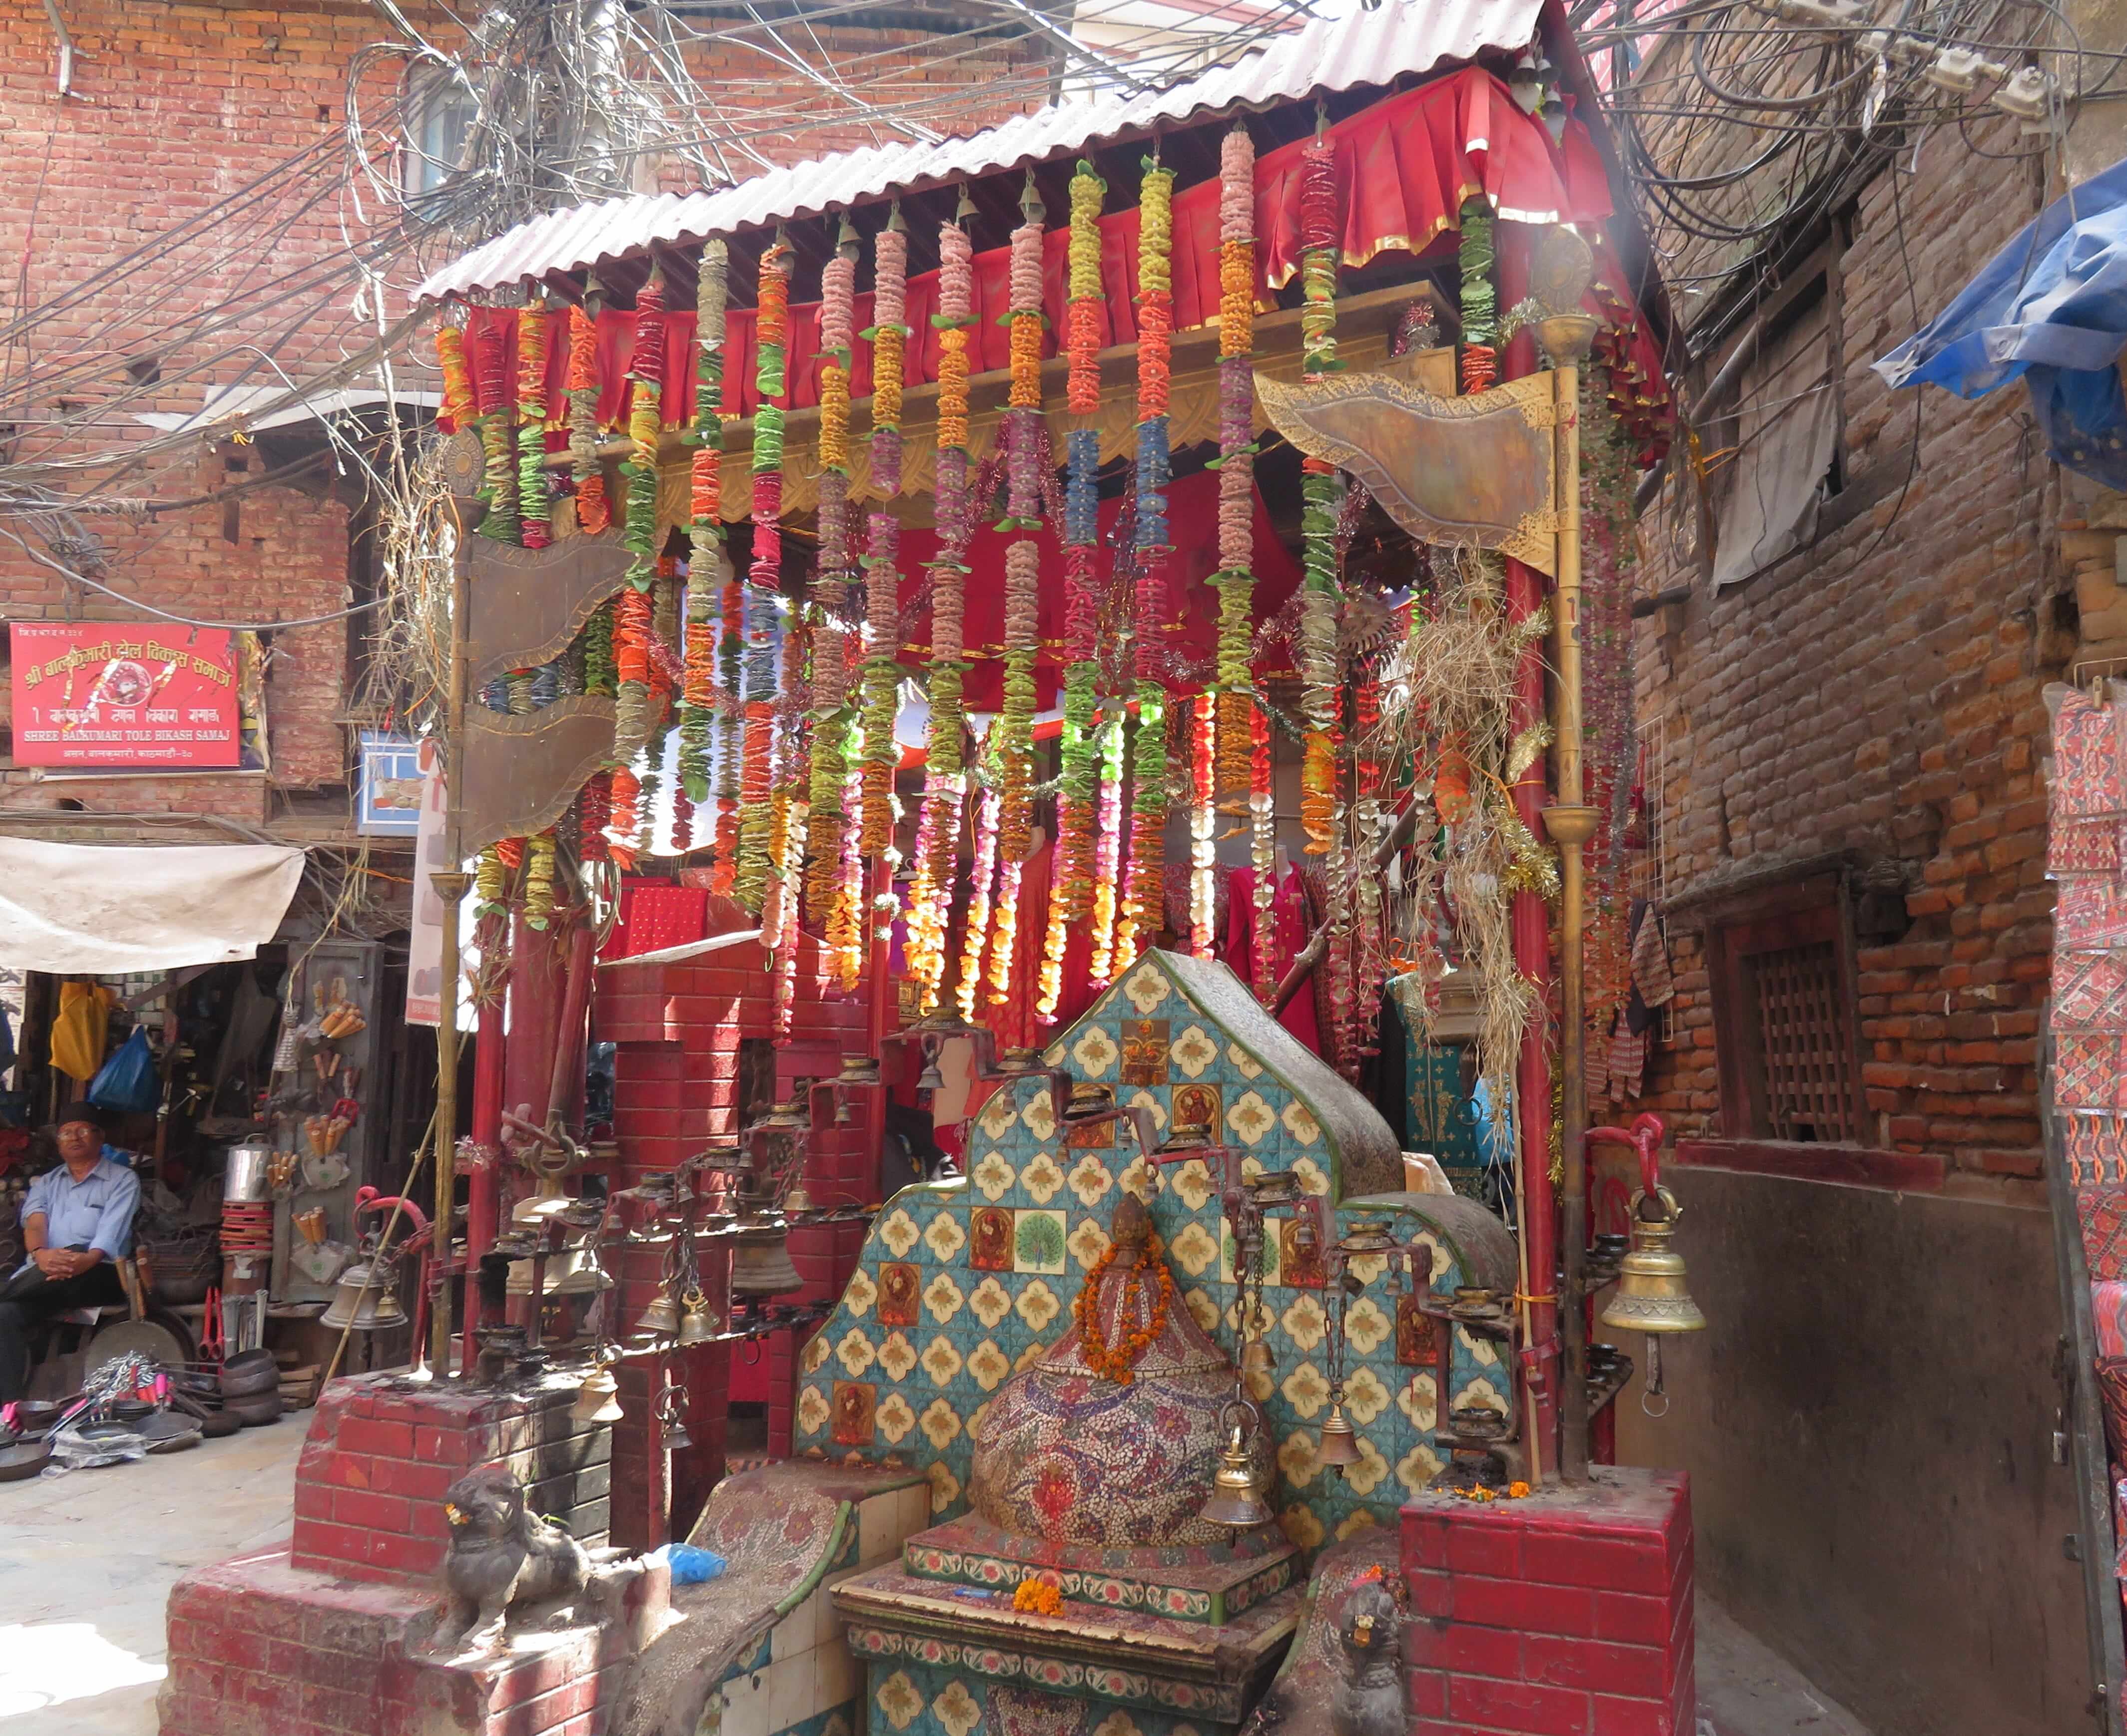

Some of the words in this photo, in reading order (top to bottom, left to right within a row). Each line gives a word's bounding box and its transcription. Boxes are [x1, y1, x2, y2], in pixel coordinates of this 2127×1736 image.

[25, 666, 42, 690] श्री
[192, 656, 232, 688] समाज
[24, 730, 59, 741] SHREE
[62, 730, 122, 741] BALKUMARI
[125, 730, 152, 741] TOLE
[154, 729, 193, 741] BIKASH
[196, 729, 230, 741] SAMAJ
